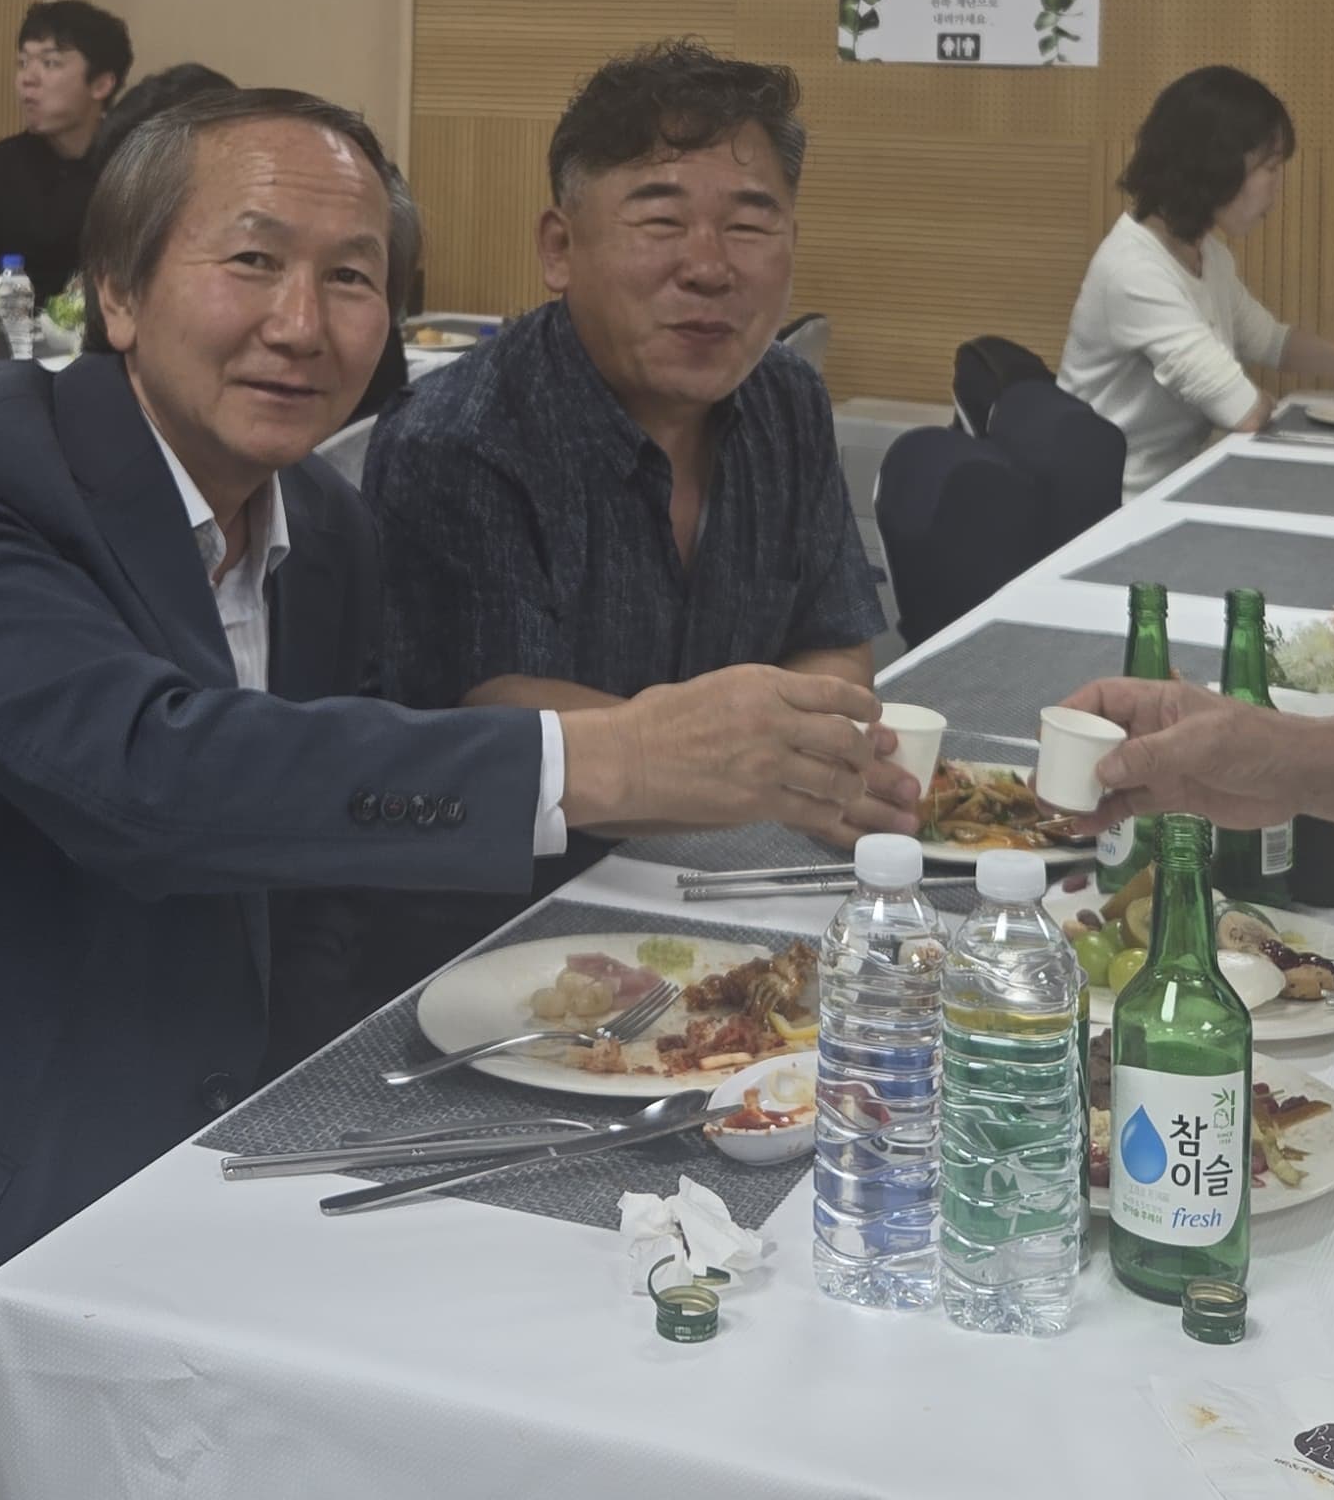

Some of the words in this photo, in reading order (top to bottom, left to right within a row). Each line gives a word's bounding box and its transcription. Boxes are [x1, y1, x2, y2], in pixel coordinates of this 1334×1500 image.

[1169, 1114, 1209, 1158] 참
[1170, 1154, 1234, 1198] 이슬
[1171, 1206, 1223, 1229] fresh
